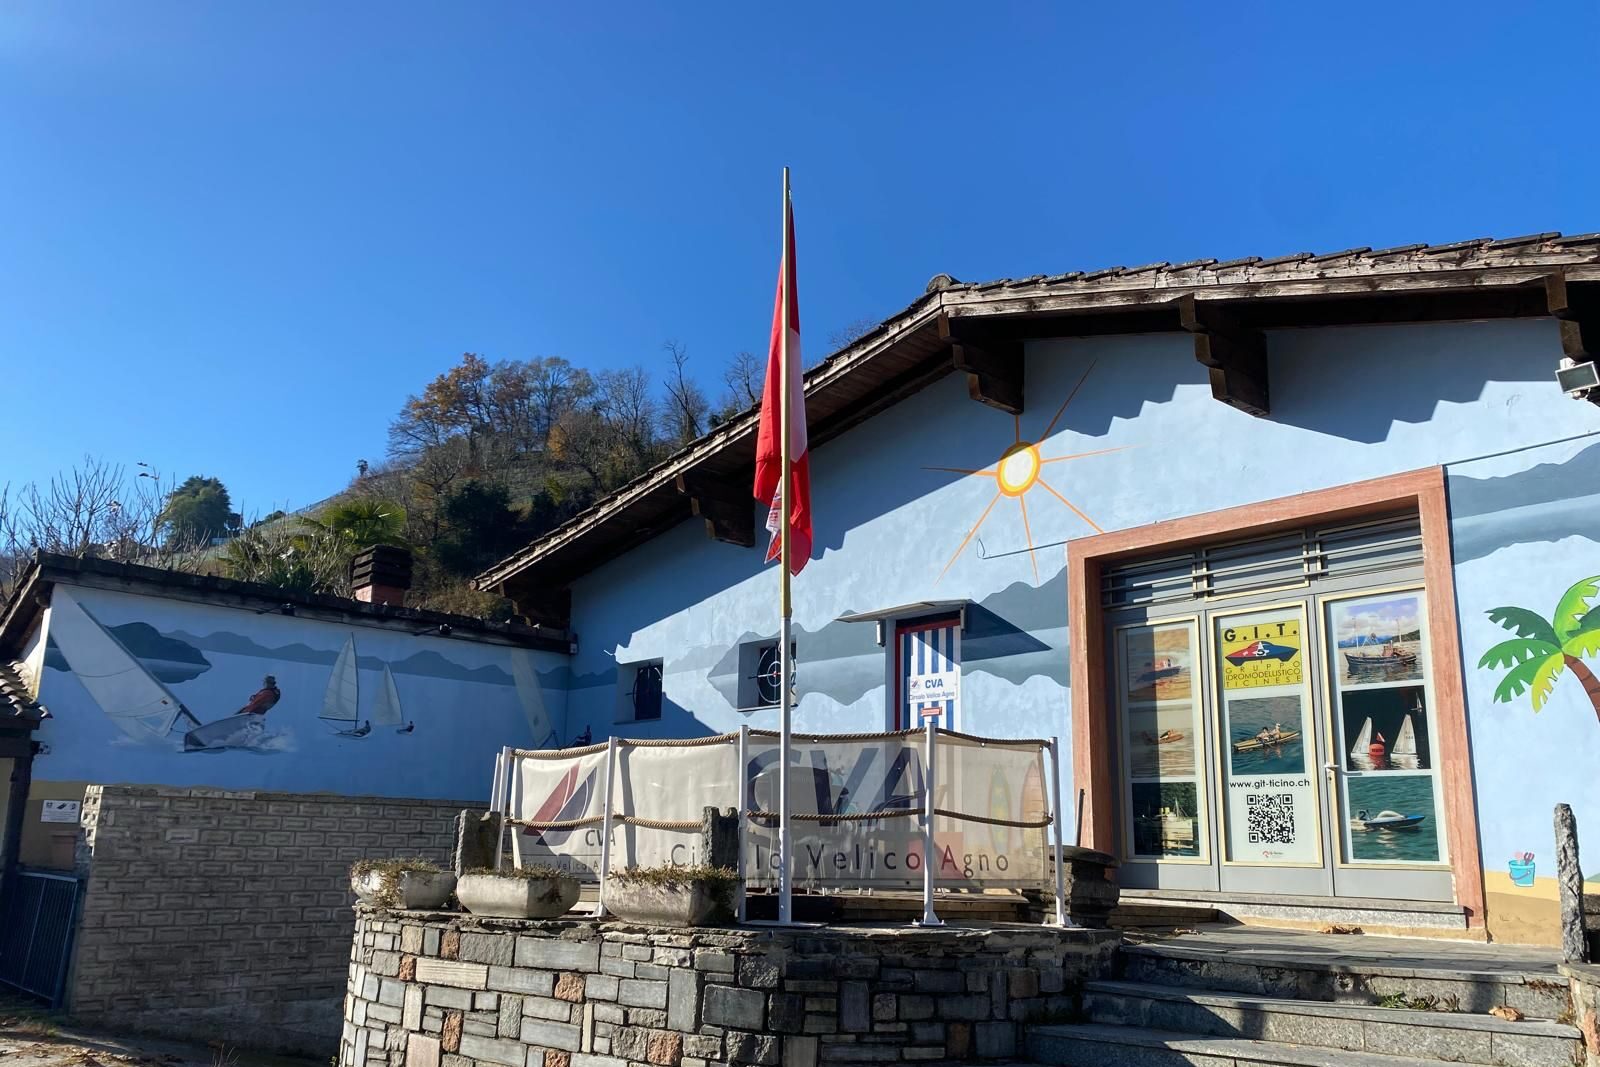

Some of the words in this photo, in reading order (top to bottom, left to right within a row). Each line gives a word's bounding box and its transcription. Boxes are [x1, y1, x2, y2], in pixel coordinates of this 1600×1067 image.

[925, 679, 943, 689] CVA
[747, 747, 927, 829] CVA
[1229, 779, 1310, 789] www.git-ticino.ch
[670, 843, 783, 870] Cilo
[806, 844, 921, 870] Velico
[941, 844, 1009, 879] Agno
